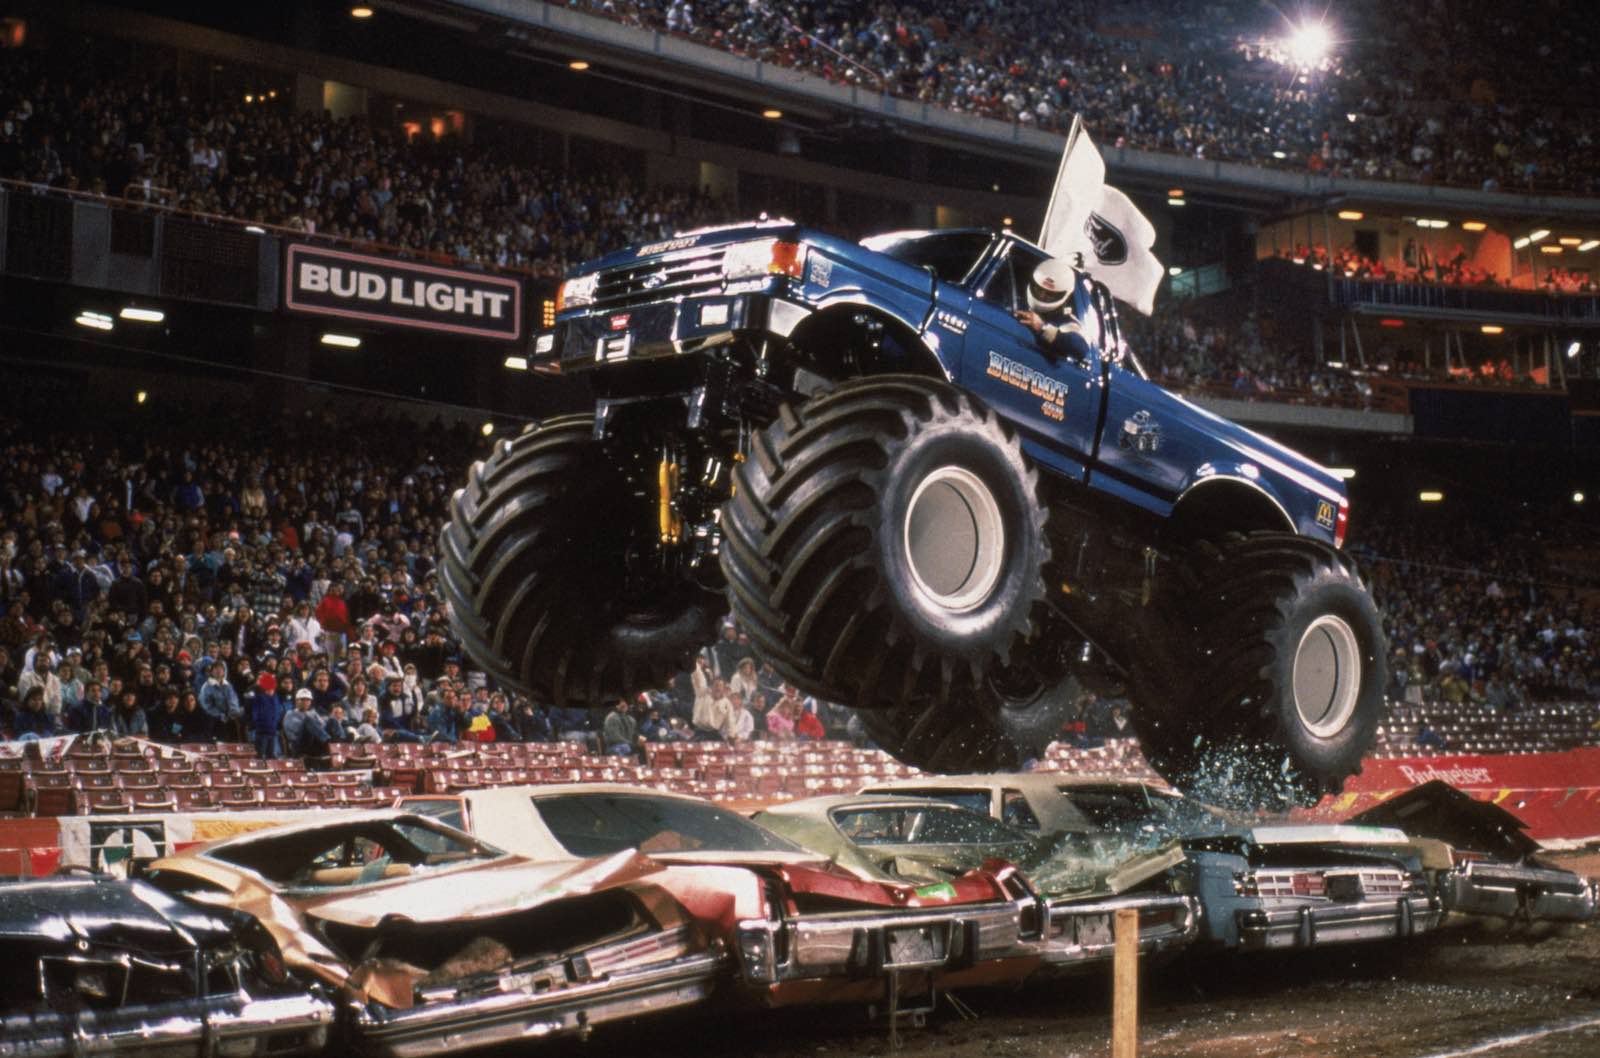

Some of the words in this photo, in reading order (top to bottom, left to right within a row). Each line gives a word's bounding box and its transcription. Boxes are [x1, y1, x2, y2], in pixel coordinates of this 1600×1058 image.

[299, 262, 387, 301] BUD
[391, 277, 509, 318] LIGHT
[986, 350, 1069, 407] BIGFOOT
[1398, 764, 1494, 785] Budweiser
